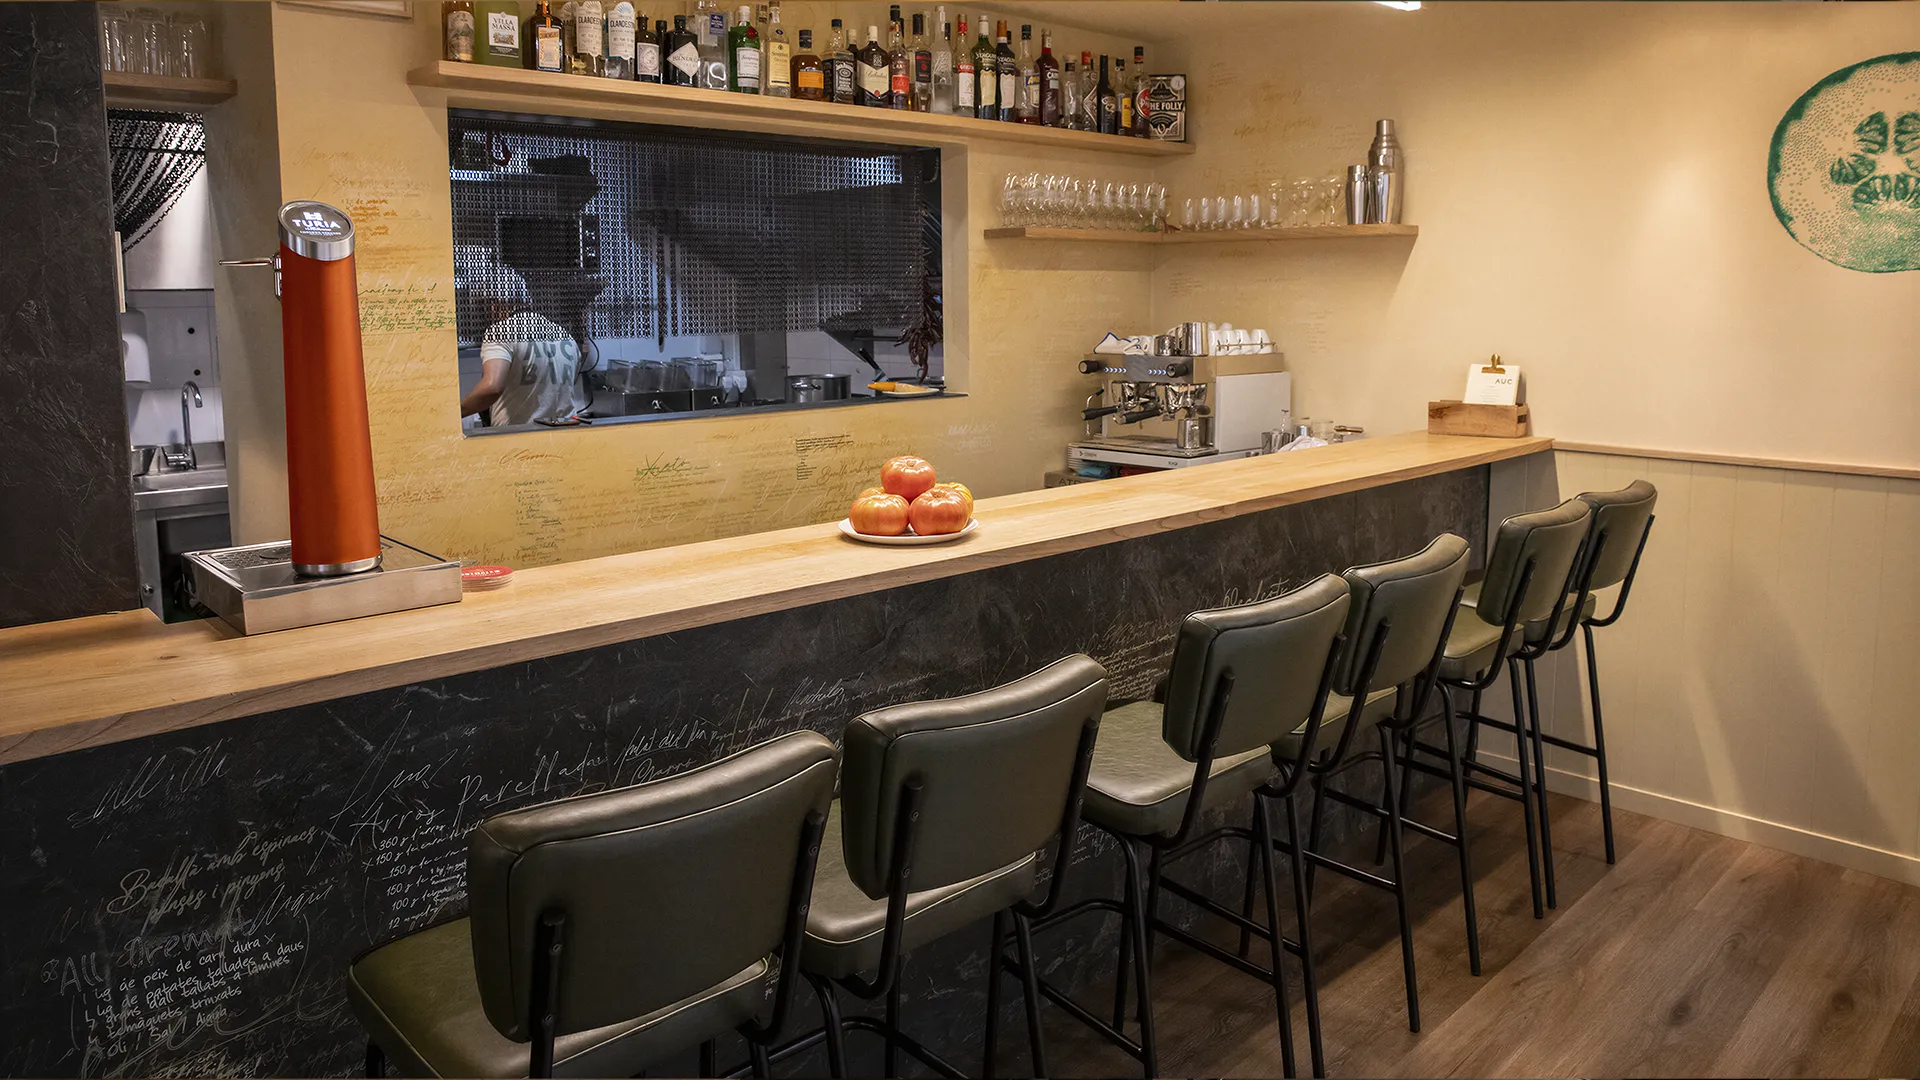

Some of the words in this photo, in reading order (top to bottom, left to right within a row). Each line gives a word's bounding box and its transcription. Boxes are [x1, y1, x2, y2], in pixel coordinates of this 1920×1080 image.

[491, 22, 516, 32] MASSA
[492, 17, 514, 26] VILLA
[1161, 101, 1183, 112] FOLLY
[292, 219, 342, 229] TURIA
[519, 359, 573, 386] BAR
[1495, 378, 1513, 386] AUC
[378, 836, 399, 851] 360
[375, 851, 394, 866] 150
[390, 864, 408, 878] 150
[386, 882, 404, 897] 150
[392, 897, 410, 911] 100
[388, 916, 401, 930] 12
[119, 978, 136, 992] de
[143, 968, 169, 989] peix
[176, 959, 192, 973] de
[233, 937, 261, 955] dura
[60, 952, 104, 997] All
[121, 994, 138, 1008] de
[146, 975, 199, 1005] patates
[206, 955, 257, 979] tallades
[262, 952, 271, 962] a
[277, 941, 304, 956] daus
[181, 975, 226, 998] tallats
[233, 971, 242, 981] a
[190, 986, 242, 1009] trinxats
